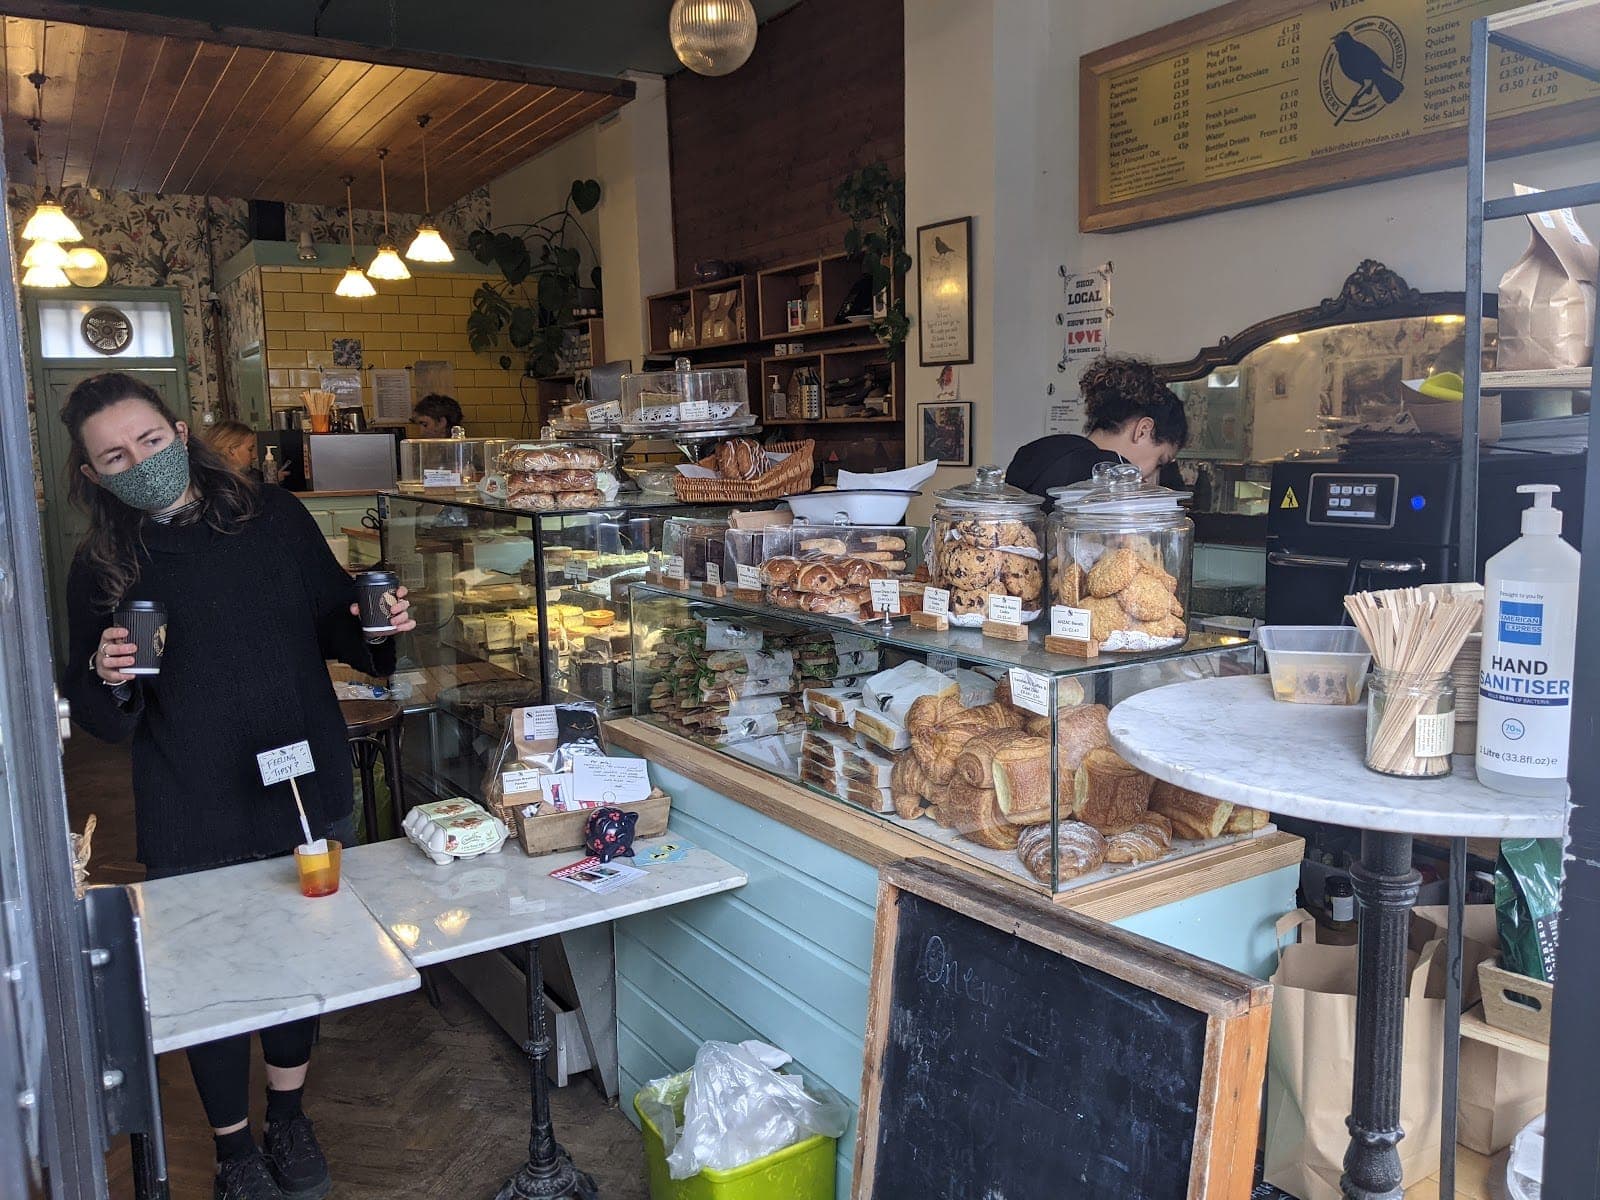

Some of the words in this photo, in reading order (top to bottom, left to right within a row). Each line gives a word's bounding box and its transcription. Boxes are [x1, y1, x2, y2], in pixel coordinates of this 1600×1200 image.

[1426, 21, 1460, 35] Toasties
[1378, 21, 1404, 69] BLACKBIRD
[1425, 34, 1456, 48] Quiche
[1424, 47, 1457, 60] Frittata
[1424, 59, 1458, 73] Sausage
[1424, 70, 1464, 86] Lebanese
[1322, 78, 1342, 113] BAKERY
[1423, 83, 1456, 99] Spinach
[1423, 100, 1449, 110] Vegan
[1423, 114, 1441, 124] Side
[1442, 106, 1465, 119] Salad
[1075, 278, 1095, 289] SHOP
[1067, 290, 1103, 306] LOCAL
[1536, 593, 1544, 601] by
[1500, 616, 1540, 624] AMERICAN
[1504, 623, 1543, 633] EXPRESS
[1491, 655, 1549, 677] HAND
[1479, 670, 1571, 696] SANITISER
[1483, 746, 1500, 760] Litre
[267, 753, 297, 770] FEELING
[1537, 921, 1555, 981] ACKBIRD
